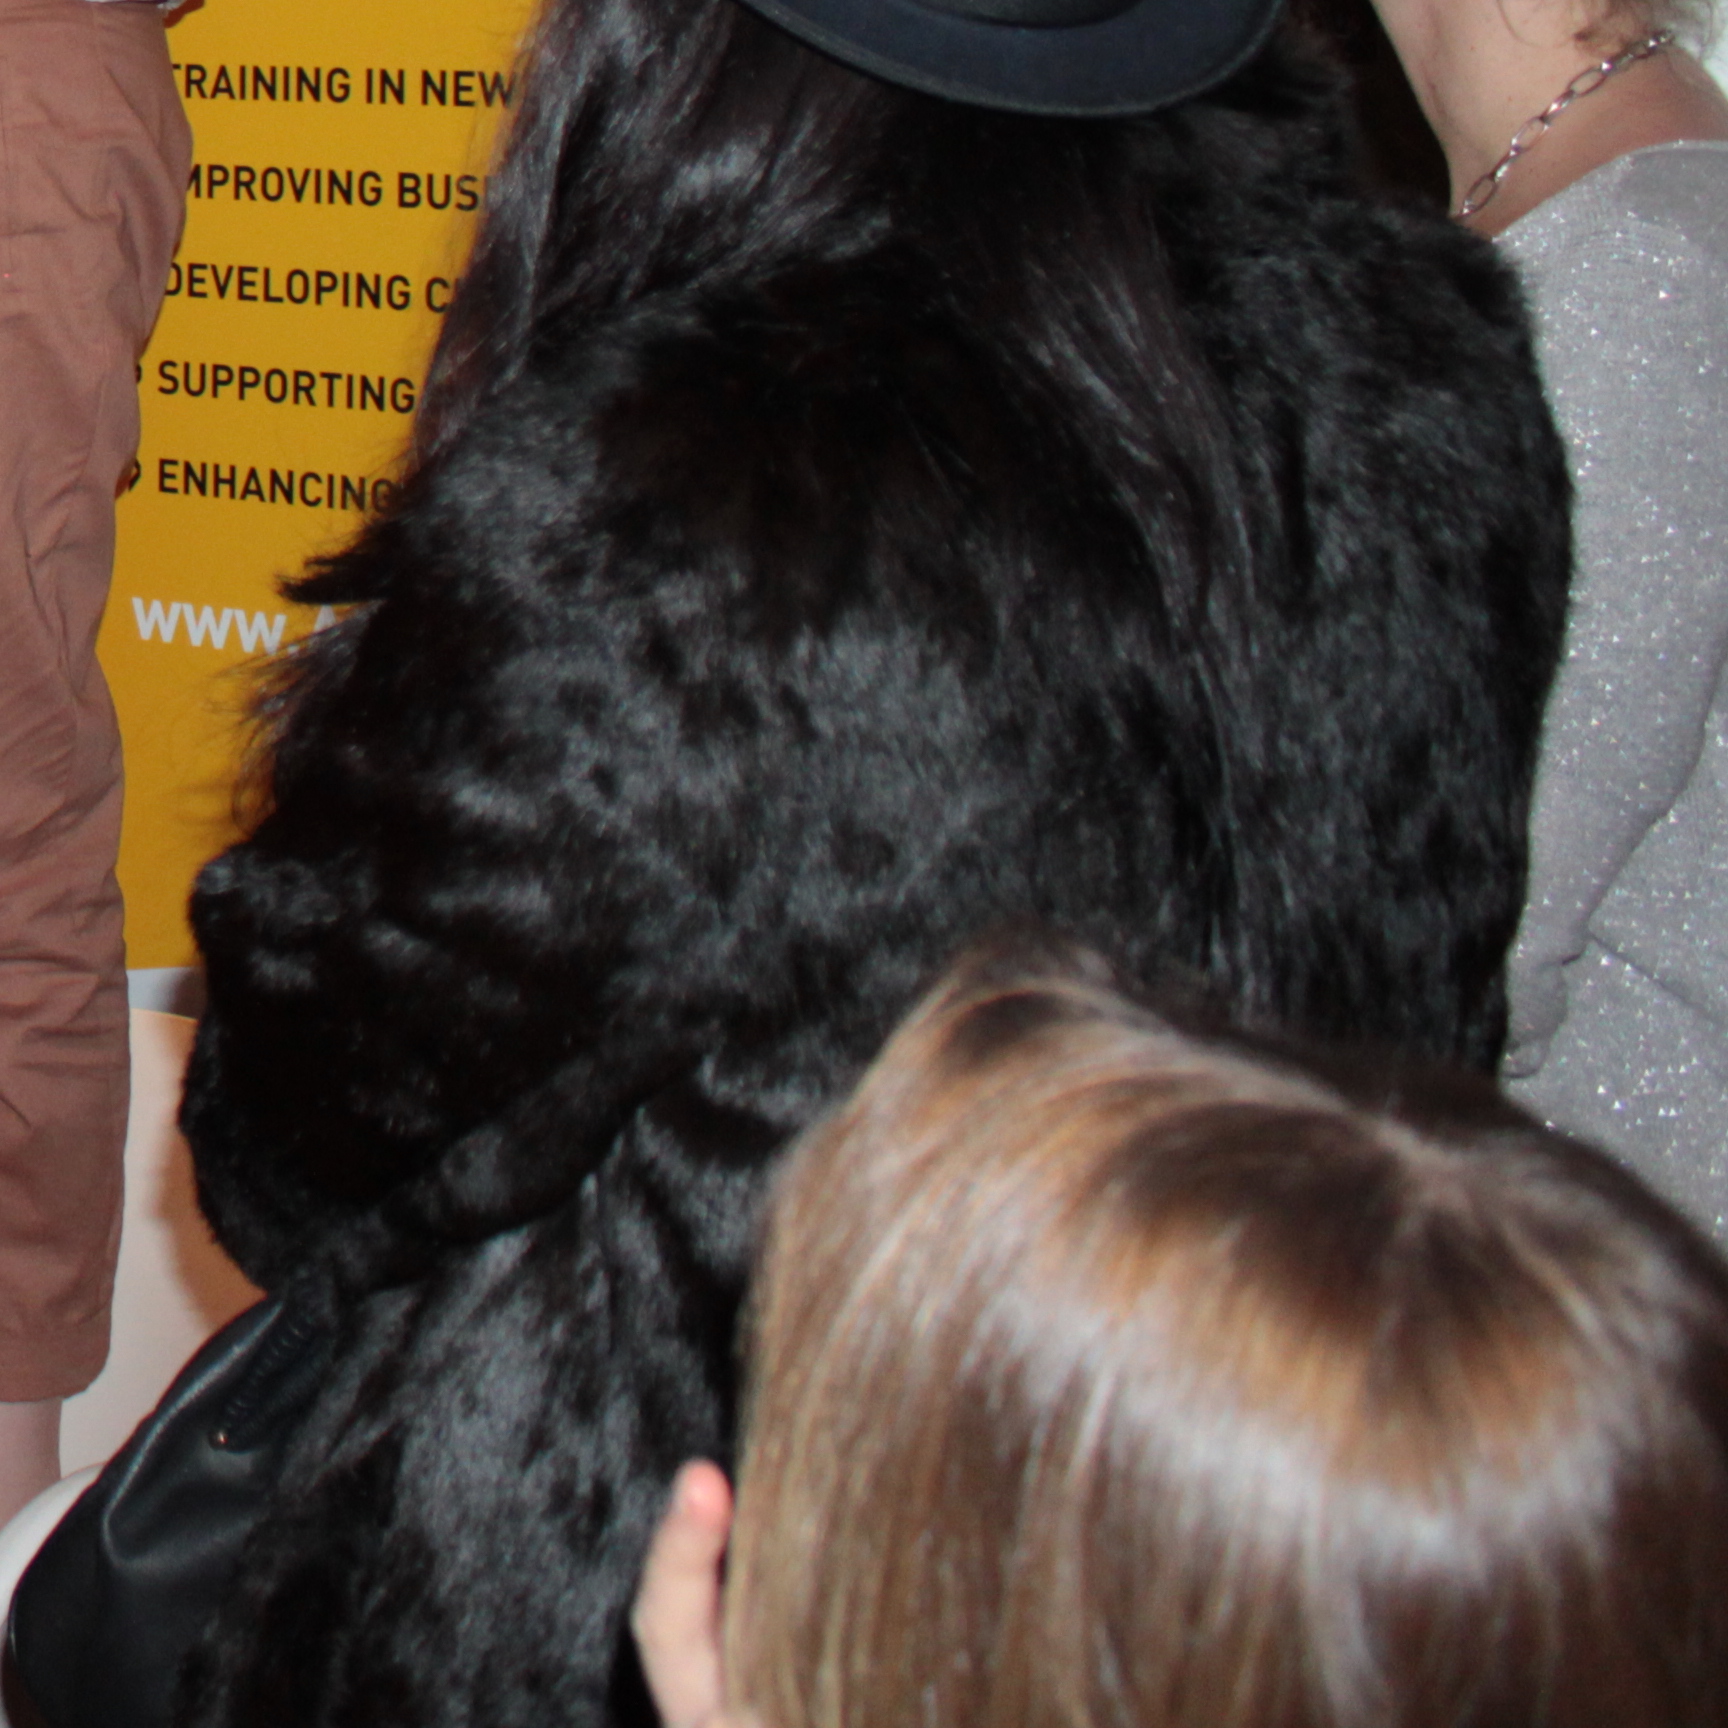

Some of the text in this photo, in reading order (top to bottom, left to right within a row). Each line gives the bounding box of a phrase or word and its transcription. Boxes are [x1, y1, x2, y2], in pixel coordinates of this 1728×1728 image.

[171, 63, 514, 108] RAINING IN NEW
[158, 359, 417, 414] SUPPORTING
[158, 457, 396, 515] ENHANCING
